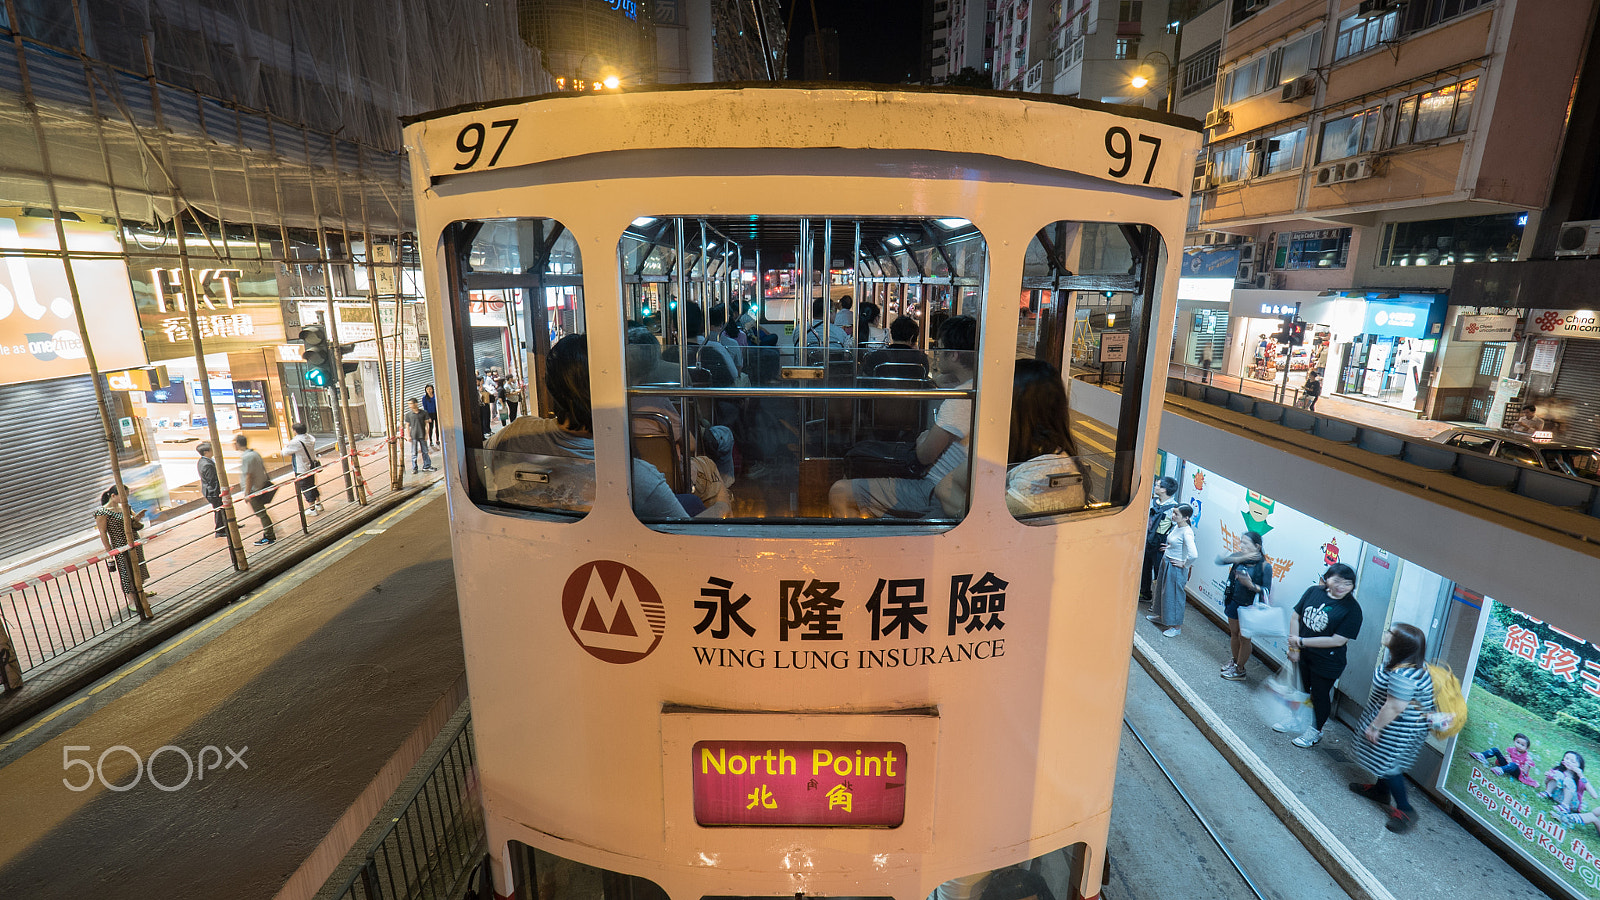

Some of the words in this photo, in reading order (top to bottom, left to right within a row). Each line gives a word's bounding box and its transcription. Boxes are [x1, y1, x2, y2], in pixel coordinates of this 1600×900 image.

[454, 119, 518, 170] 97
[1105, 126, 1162, 184] 97
[151, 268, 244, 313] HKT
[1564, 324, 1600, 332] unicom
[1565, 315, 1596, 324] China
[13, 344, 26, 354] as
[693, 572, 1009, 641] 永隆保險
[692, 646, 766, 669] WING
[773, 649, 849, 669] LUNG
[857, 639, 1006, 669] INSURANCE
[701, 748, 797, 775] North
[812, 749, 897, 777] Point
[746, 784, 853, 813] 北角
[1472, 768, 1530, 816] Prevent
[1537, 814, 1565, 841] hill
[1468, 782, 1497, 810] Keep
[1501, 806, 1534, 841] Hong
[1538, 834, 1576, 871] Kong
